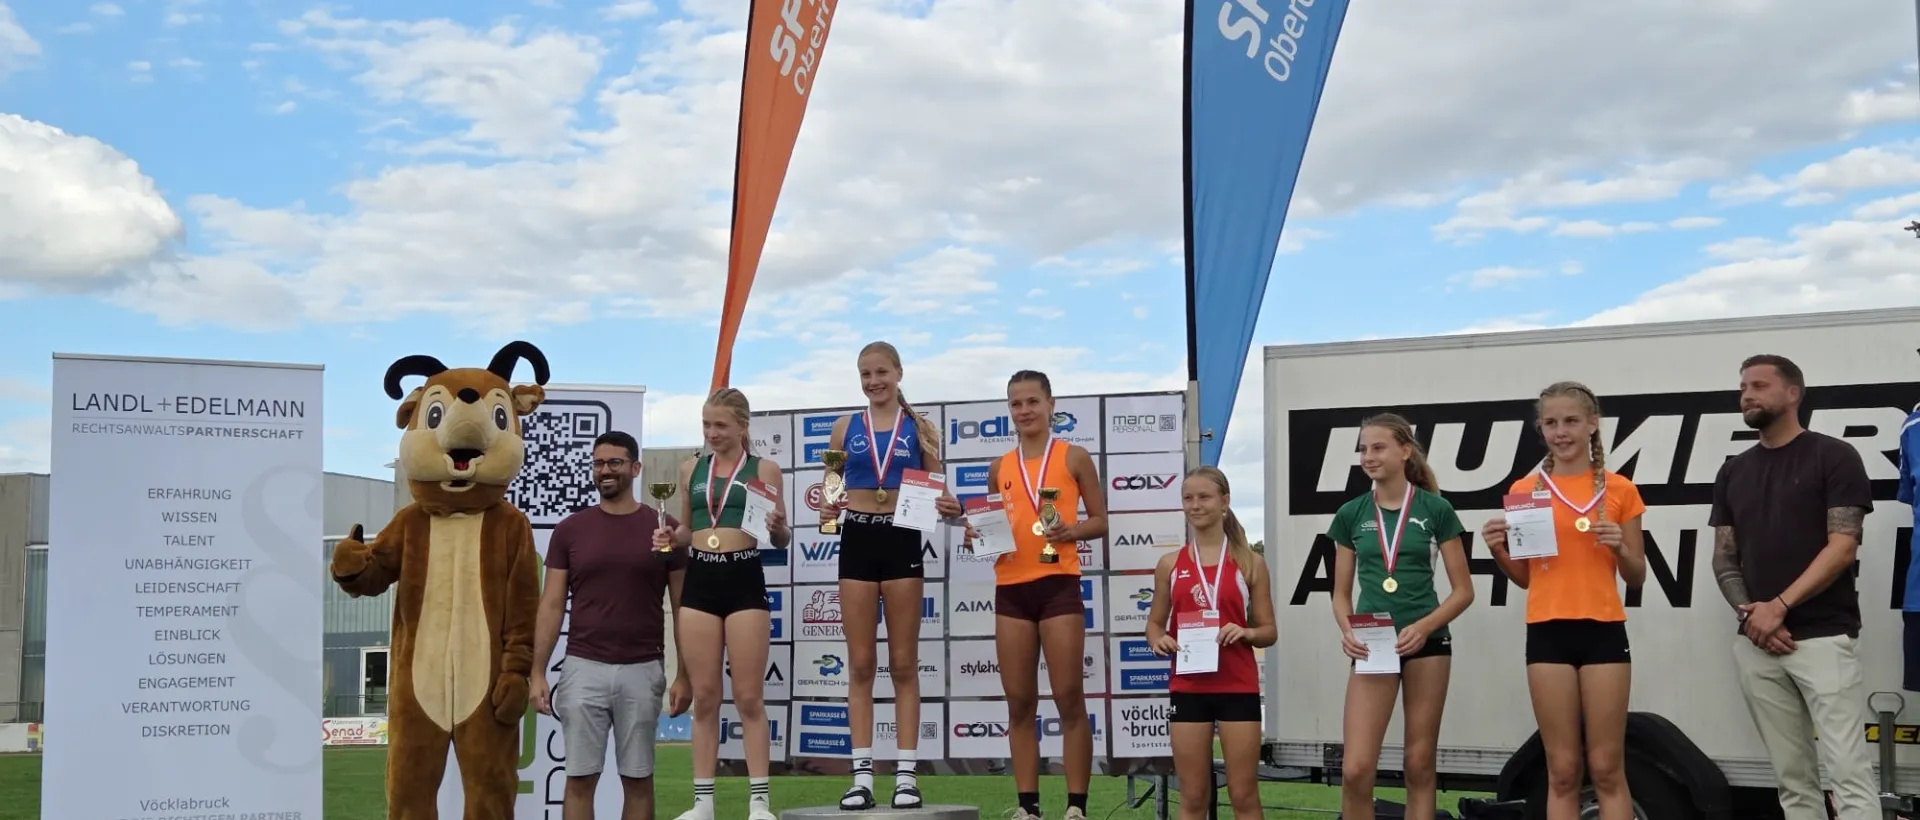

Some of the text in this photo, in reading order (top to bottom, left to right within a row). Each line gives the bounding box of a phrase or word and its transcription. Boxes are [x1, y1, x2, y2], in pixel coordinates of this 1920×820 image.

[71, 422, 304, 440] RECHTSANWALTSPARTNERSCHAFT
[148, 487, 232, 501] ERFAHRUNG
[161, 511, 217, 524] WISSEN
[163, 535, 215, 547] TALENT
[1114, 533, 1154, 546] AIM
[125, 556, 252, 571] UNABHÄNGIGKEIT
[697, 551, 727, 563] PUMA
[135, 582, 241, 595] LEIDENSCHAFT
[136, 605, 239, 618] TEMPERAMENT
[955, 600, 993, 612] AIM
[154, 629, 220, 642] EINBLICK
[149, 651, 226, 665] LÖSUNGEN
[138, 676, 236, 690] ENGAGEMENT
[122, 700, 250, 714] VERANTWORTUNG
[141, 724, 231, 738] DISKRETION
[140, 797, 230, 812] Vöcklabruck
